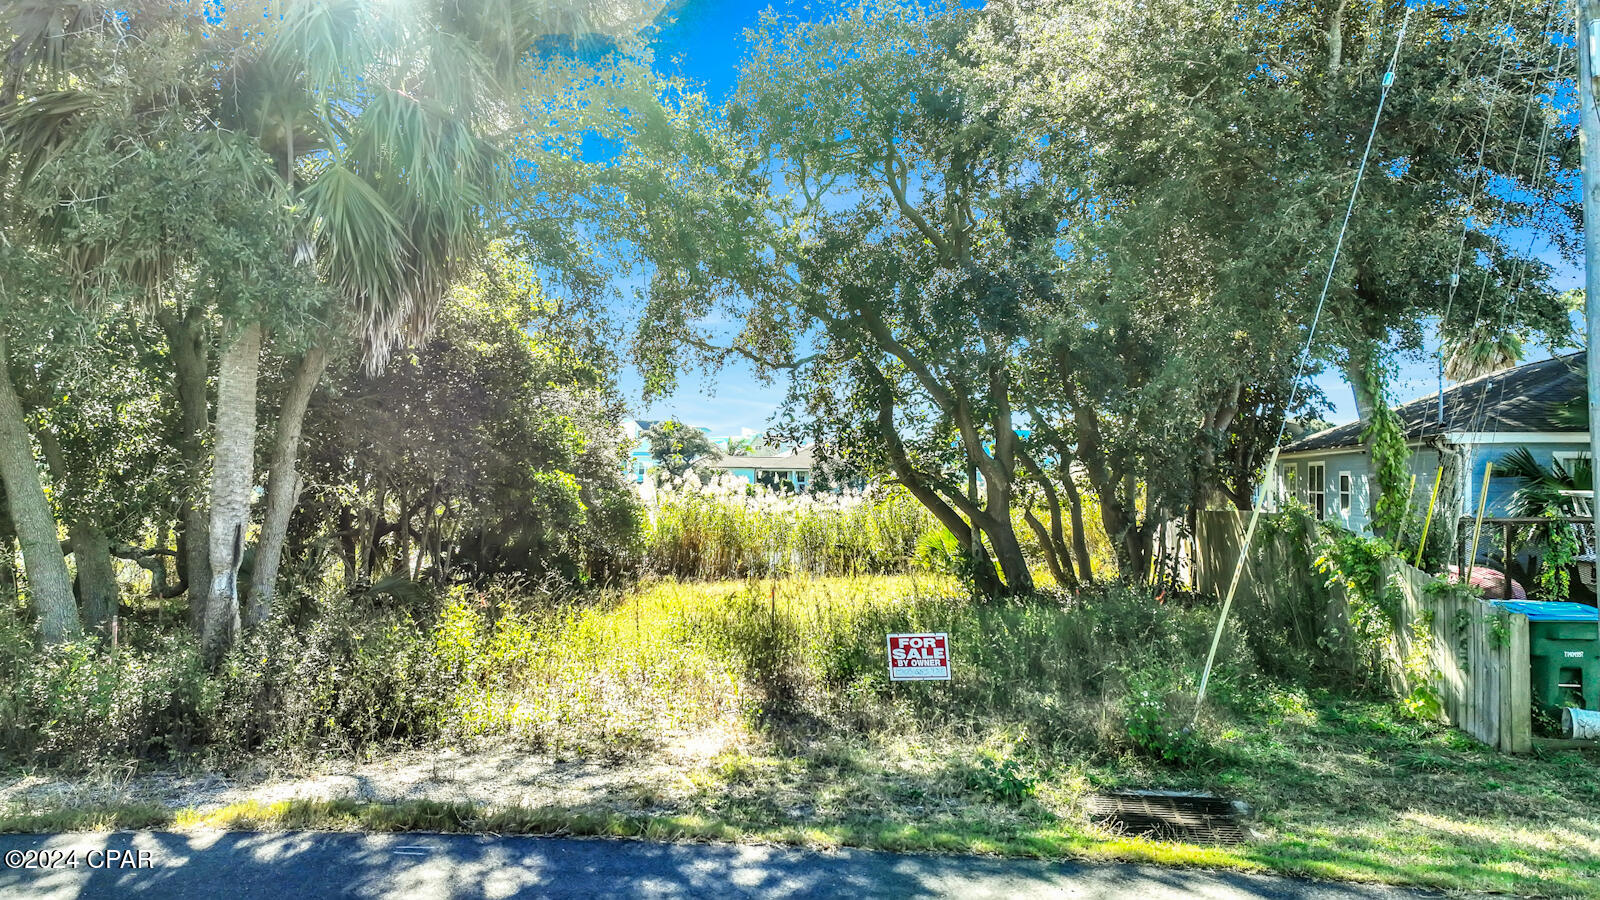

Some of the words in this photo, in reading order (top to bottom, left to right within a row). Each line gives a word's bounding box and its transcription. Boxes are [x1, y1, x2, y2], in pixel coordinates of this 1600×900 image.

[898, 637, 936, 648] FOR
[892, 647, 945, 660] SALE
[897, 659, 909, 667] BY
[911, 659, 941, 667] OWNER
